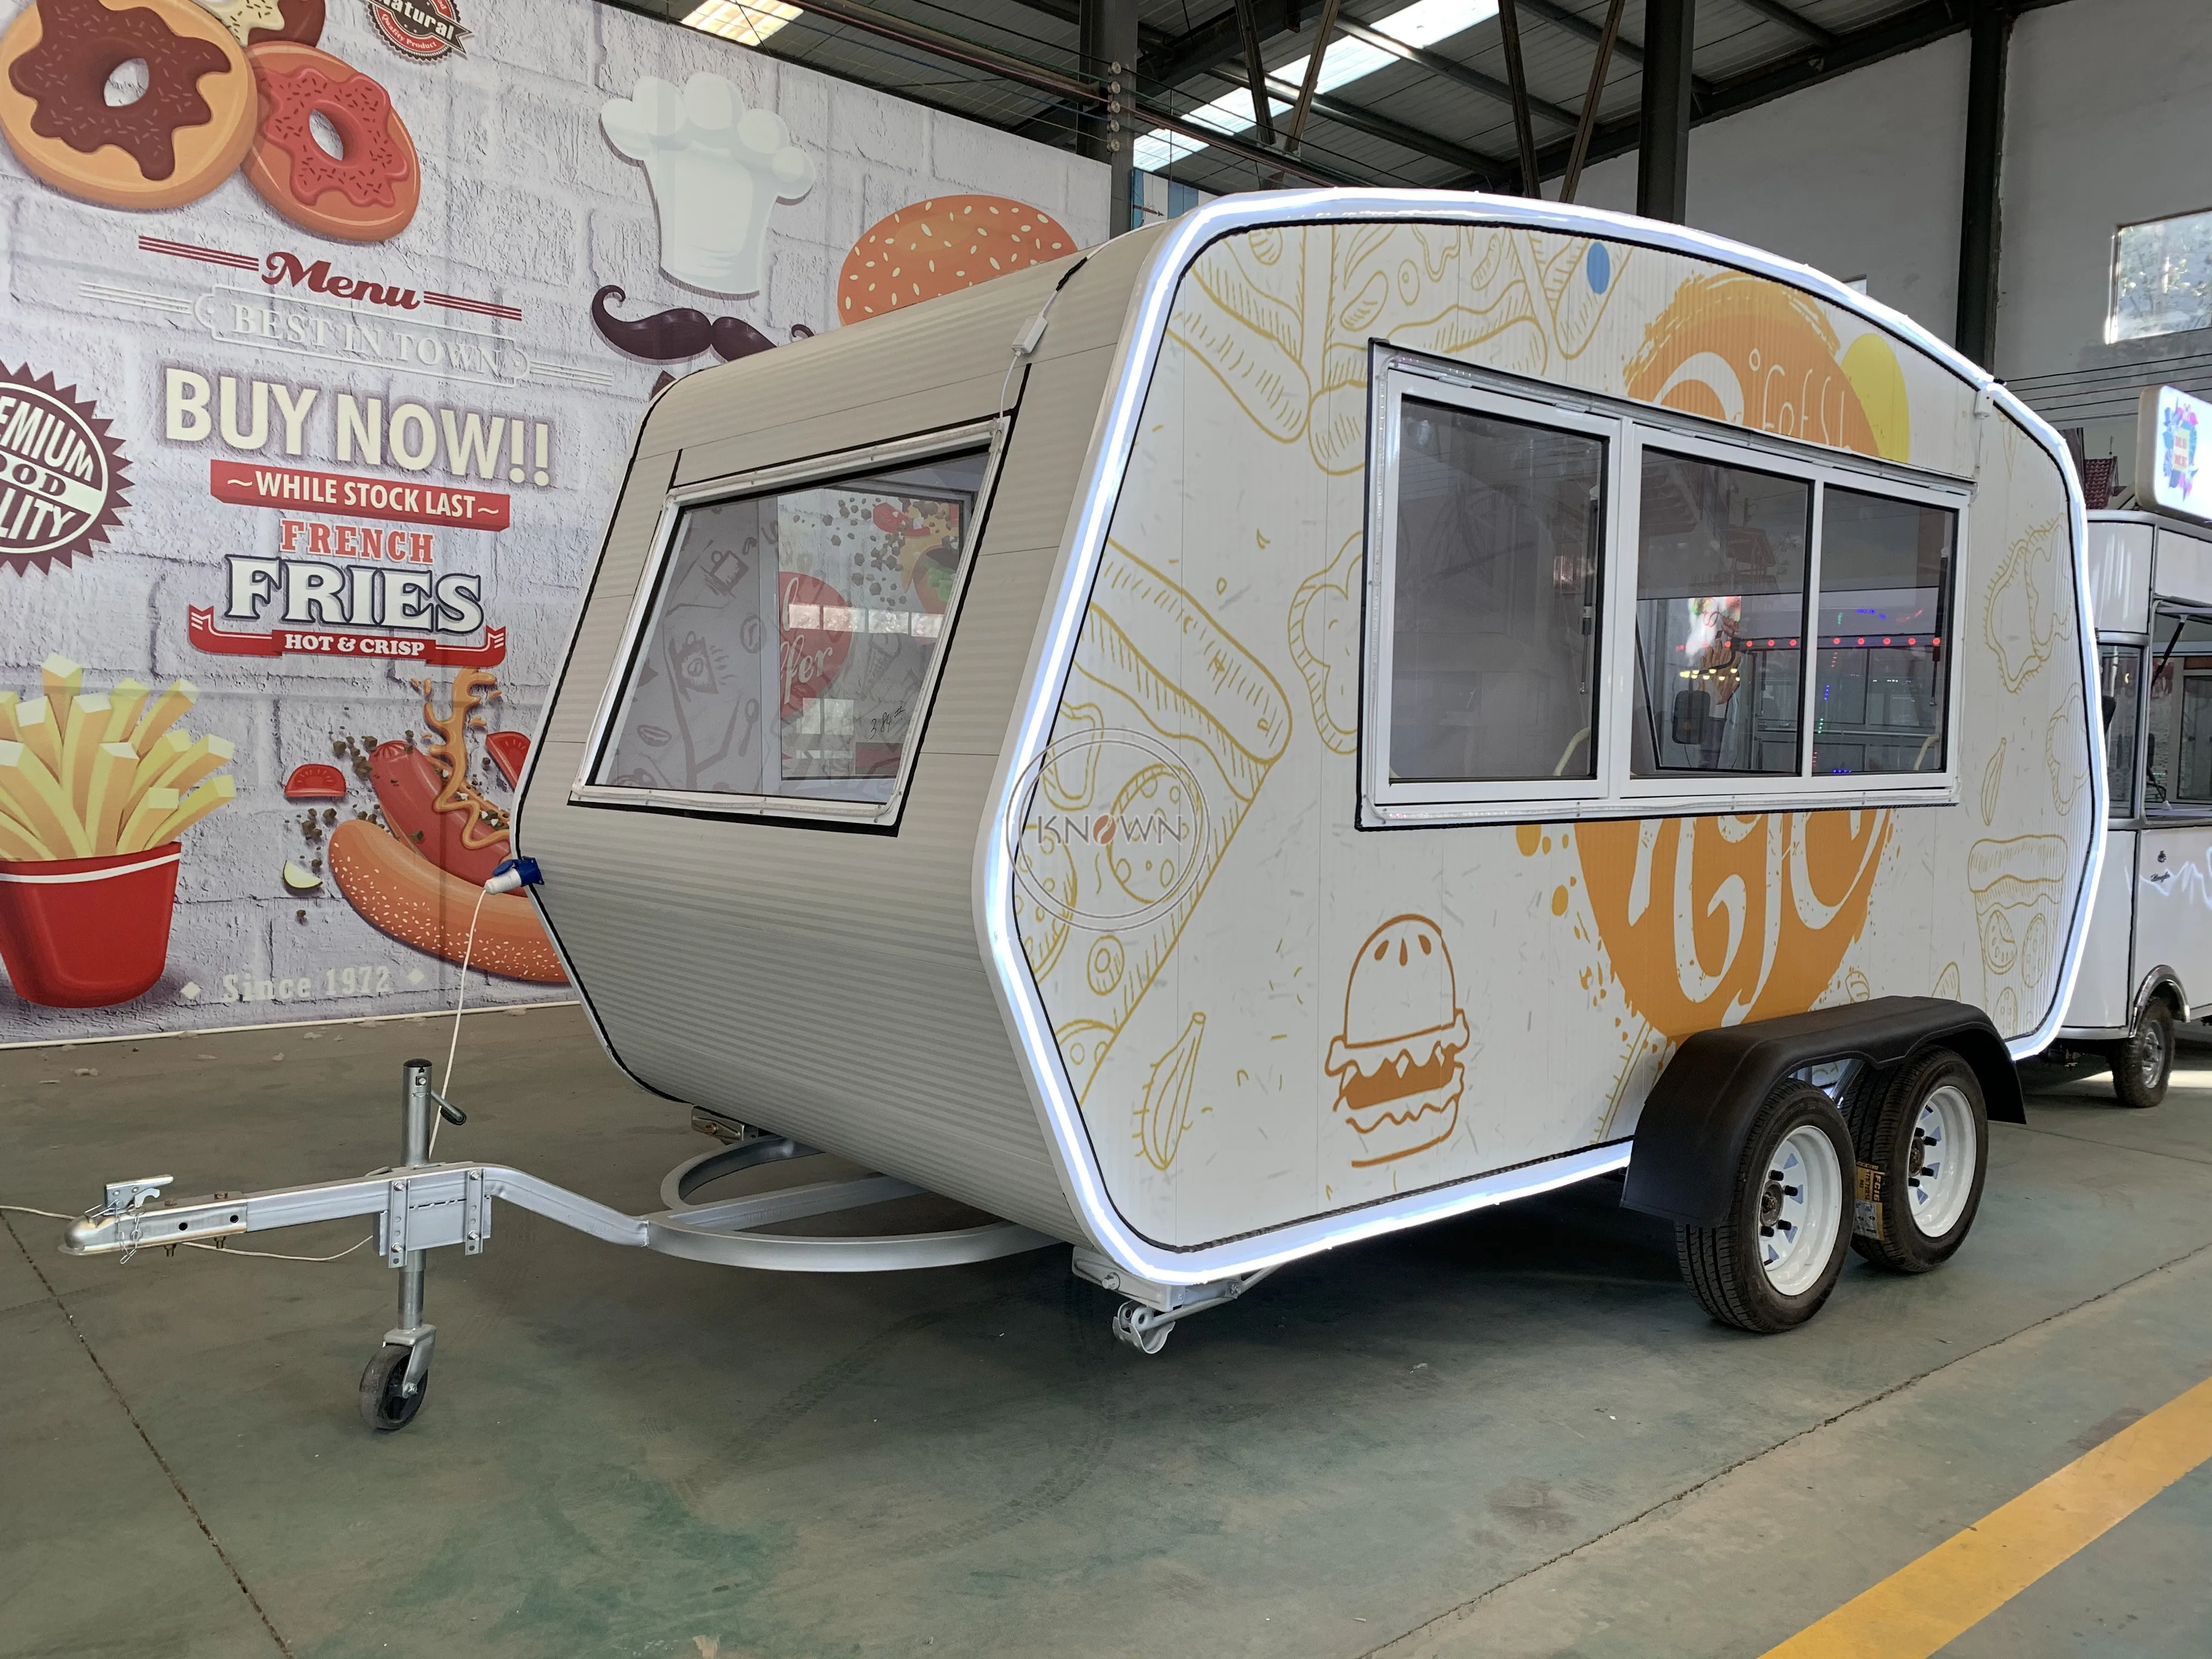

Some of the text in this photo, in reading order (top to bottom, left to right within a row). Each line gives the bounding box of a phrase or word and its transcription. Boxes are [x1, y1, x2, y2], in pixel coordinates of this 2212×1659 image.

[381, 14, 437, 49] Quality Product
[383, 0, 454, 40] atural
[262, 251, 420, 309] Menu
[231, 303, 502, 376] BEST IN TOWN
[0, 396, 94, 482] EMIUM
[166, 368, 549, 487] BUY NOW!!
[0, 487, 76, 540] LITY
[344, 482, 419, 513] STOCK
[280, 518, 434, 564] FRENCH
[225, 554, 484, 634] FRIES
[285, 634, 425, 656] HOT & CRISP
[223, 966, 390, 1002] Since 1972
